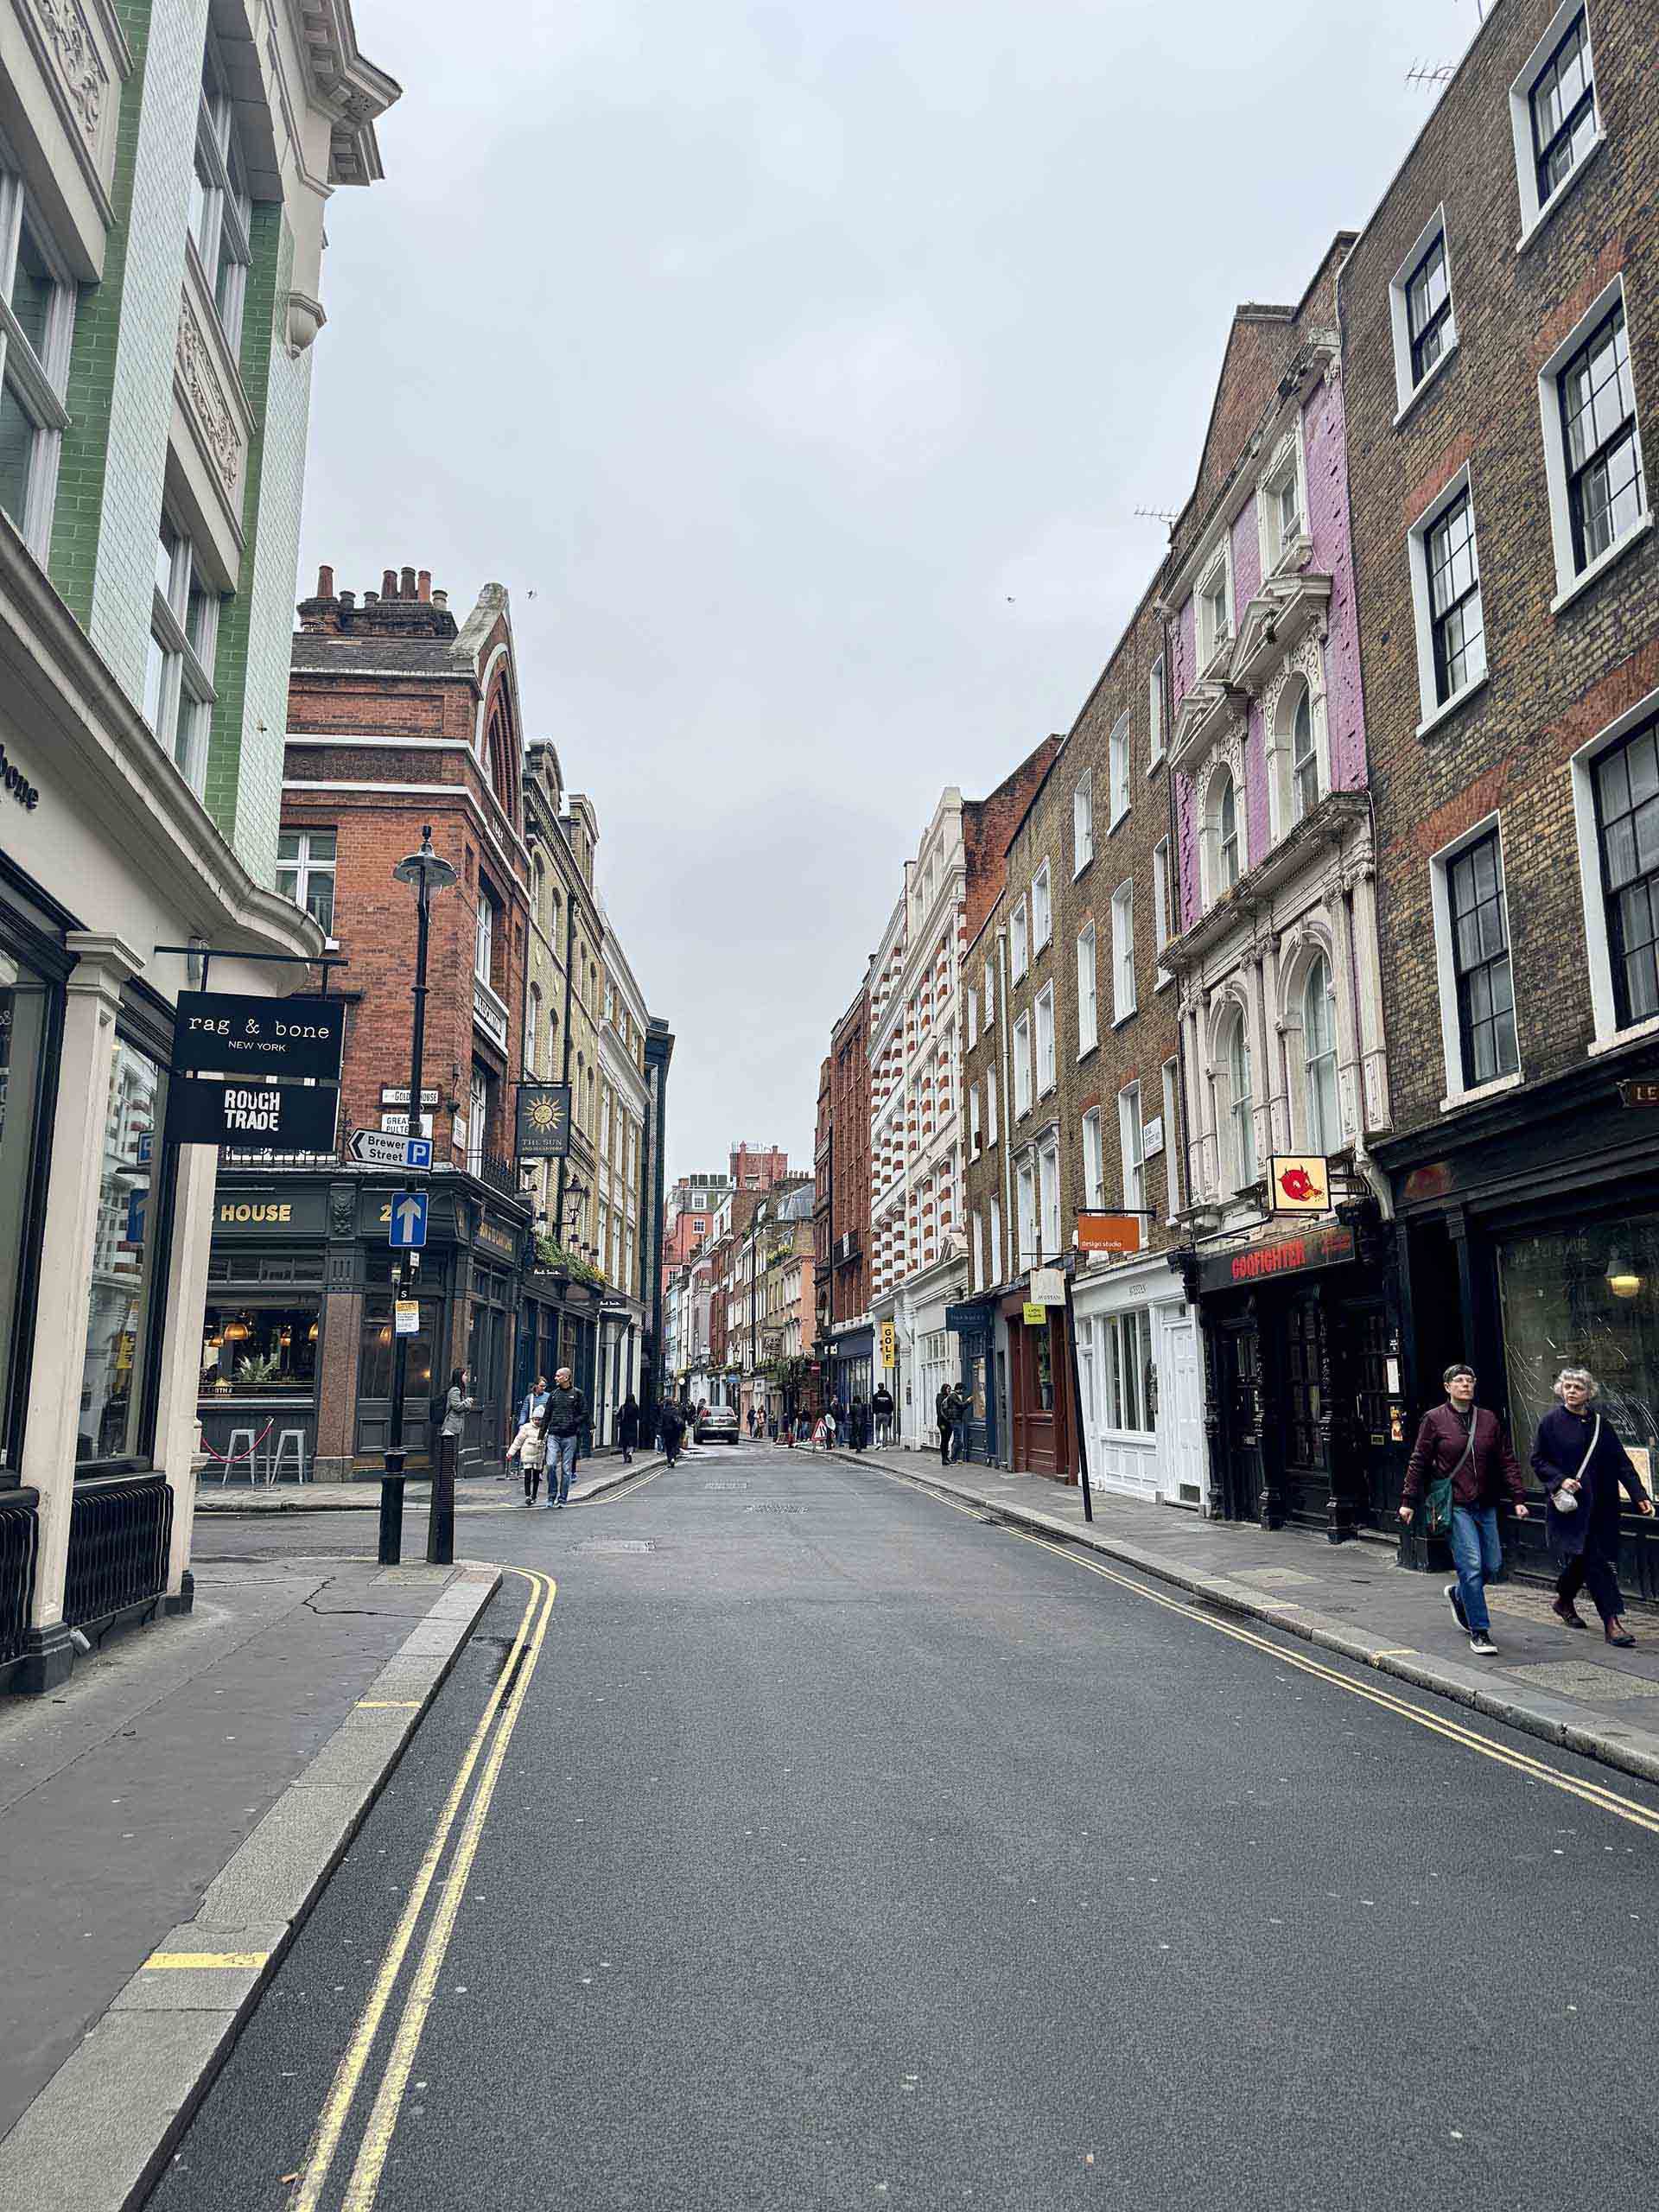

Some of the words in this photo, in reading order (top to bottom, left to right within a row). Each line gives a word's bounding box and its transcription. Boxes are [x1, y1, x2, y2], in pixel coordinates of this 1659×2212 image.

[188, 1017, 231, 1035] rag
[245, 1019, 260, 1034] &
[275, 1020, 329, 1039] bone
[228, 1040, 253, 1050] NEW
[257, 1042, 286, 1052] YORK
[224, 1089, 281, 1111] ROUGH
[224, 1109, 280, 1132] TRADE
[367, 1135, 406, 1150] Brewer
[369, 1148, 404, 1162] Street
[220, 1204, 292, 1222] HOUSE
[1103, 1240, 1122, 1249] studio
